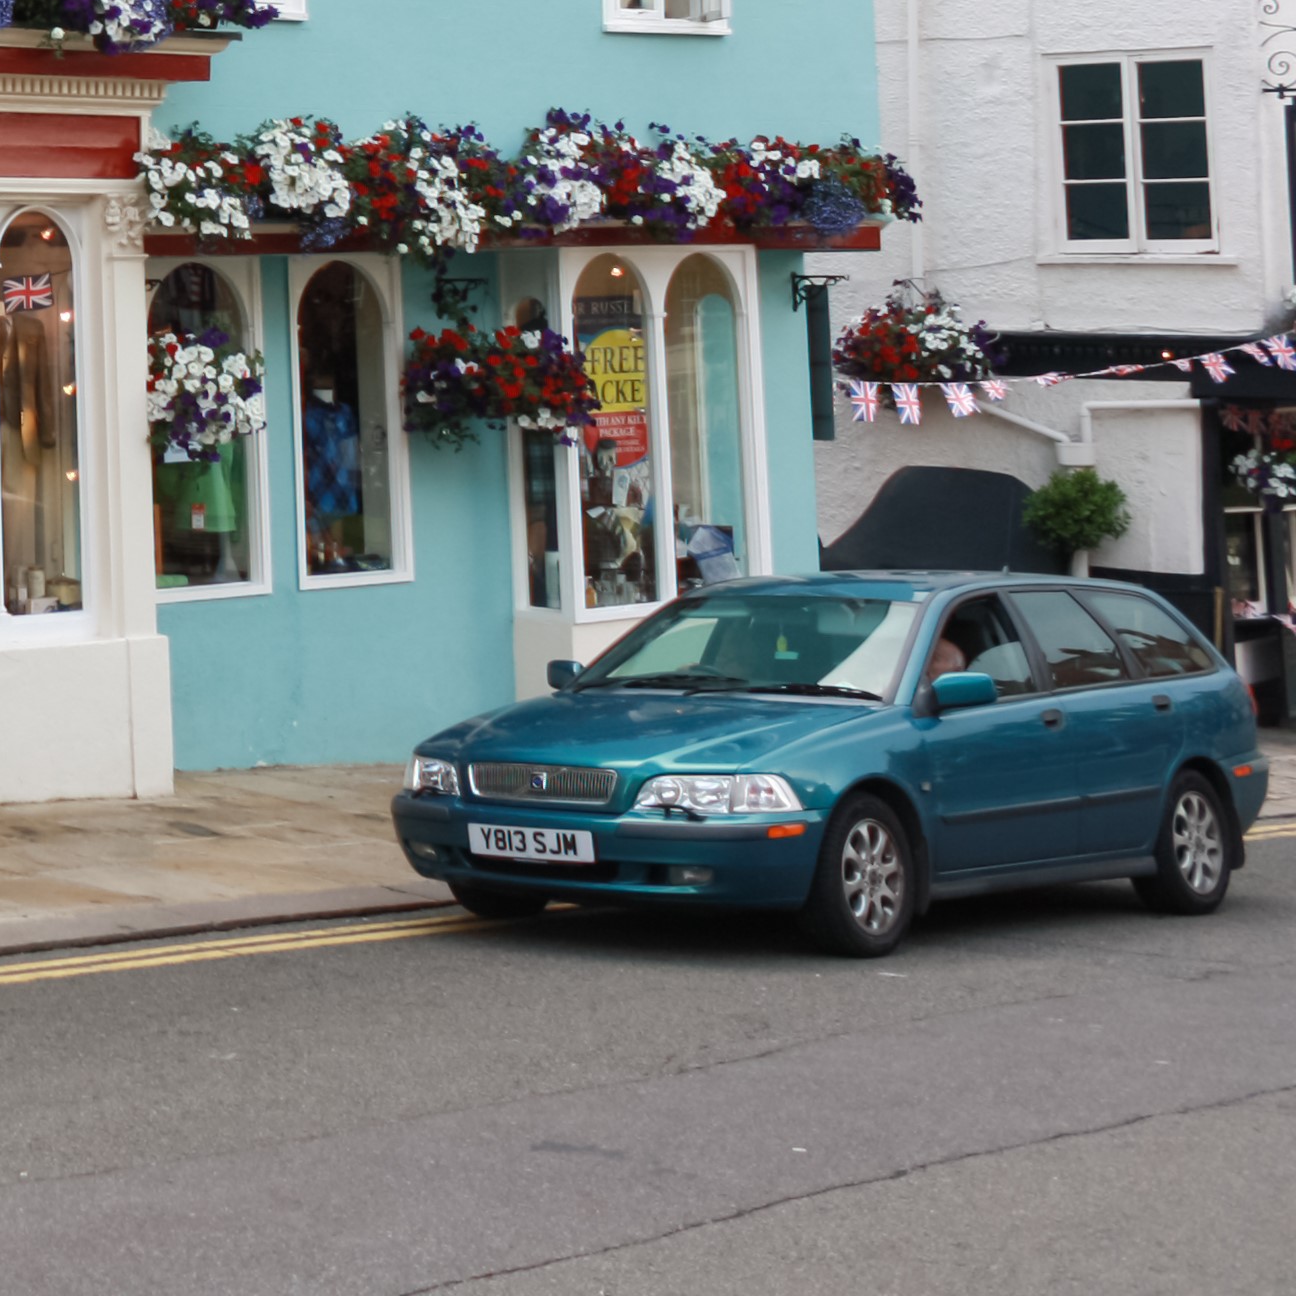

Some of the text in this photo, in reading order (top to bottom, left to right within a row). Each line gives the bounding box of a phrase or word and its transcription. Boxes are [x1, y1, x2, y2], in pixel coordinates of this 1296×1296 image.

[591, 299, 632, 315] RUSSE
[590, 345, 645, 375] FREE
[594, 379, 643, 404] CKE
[599, 426, 636, 438] PACKAGE
[481, 827, 578, 856] Y813 SJM
